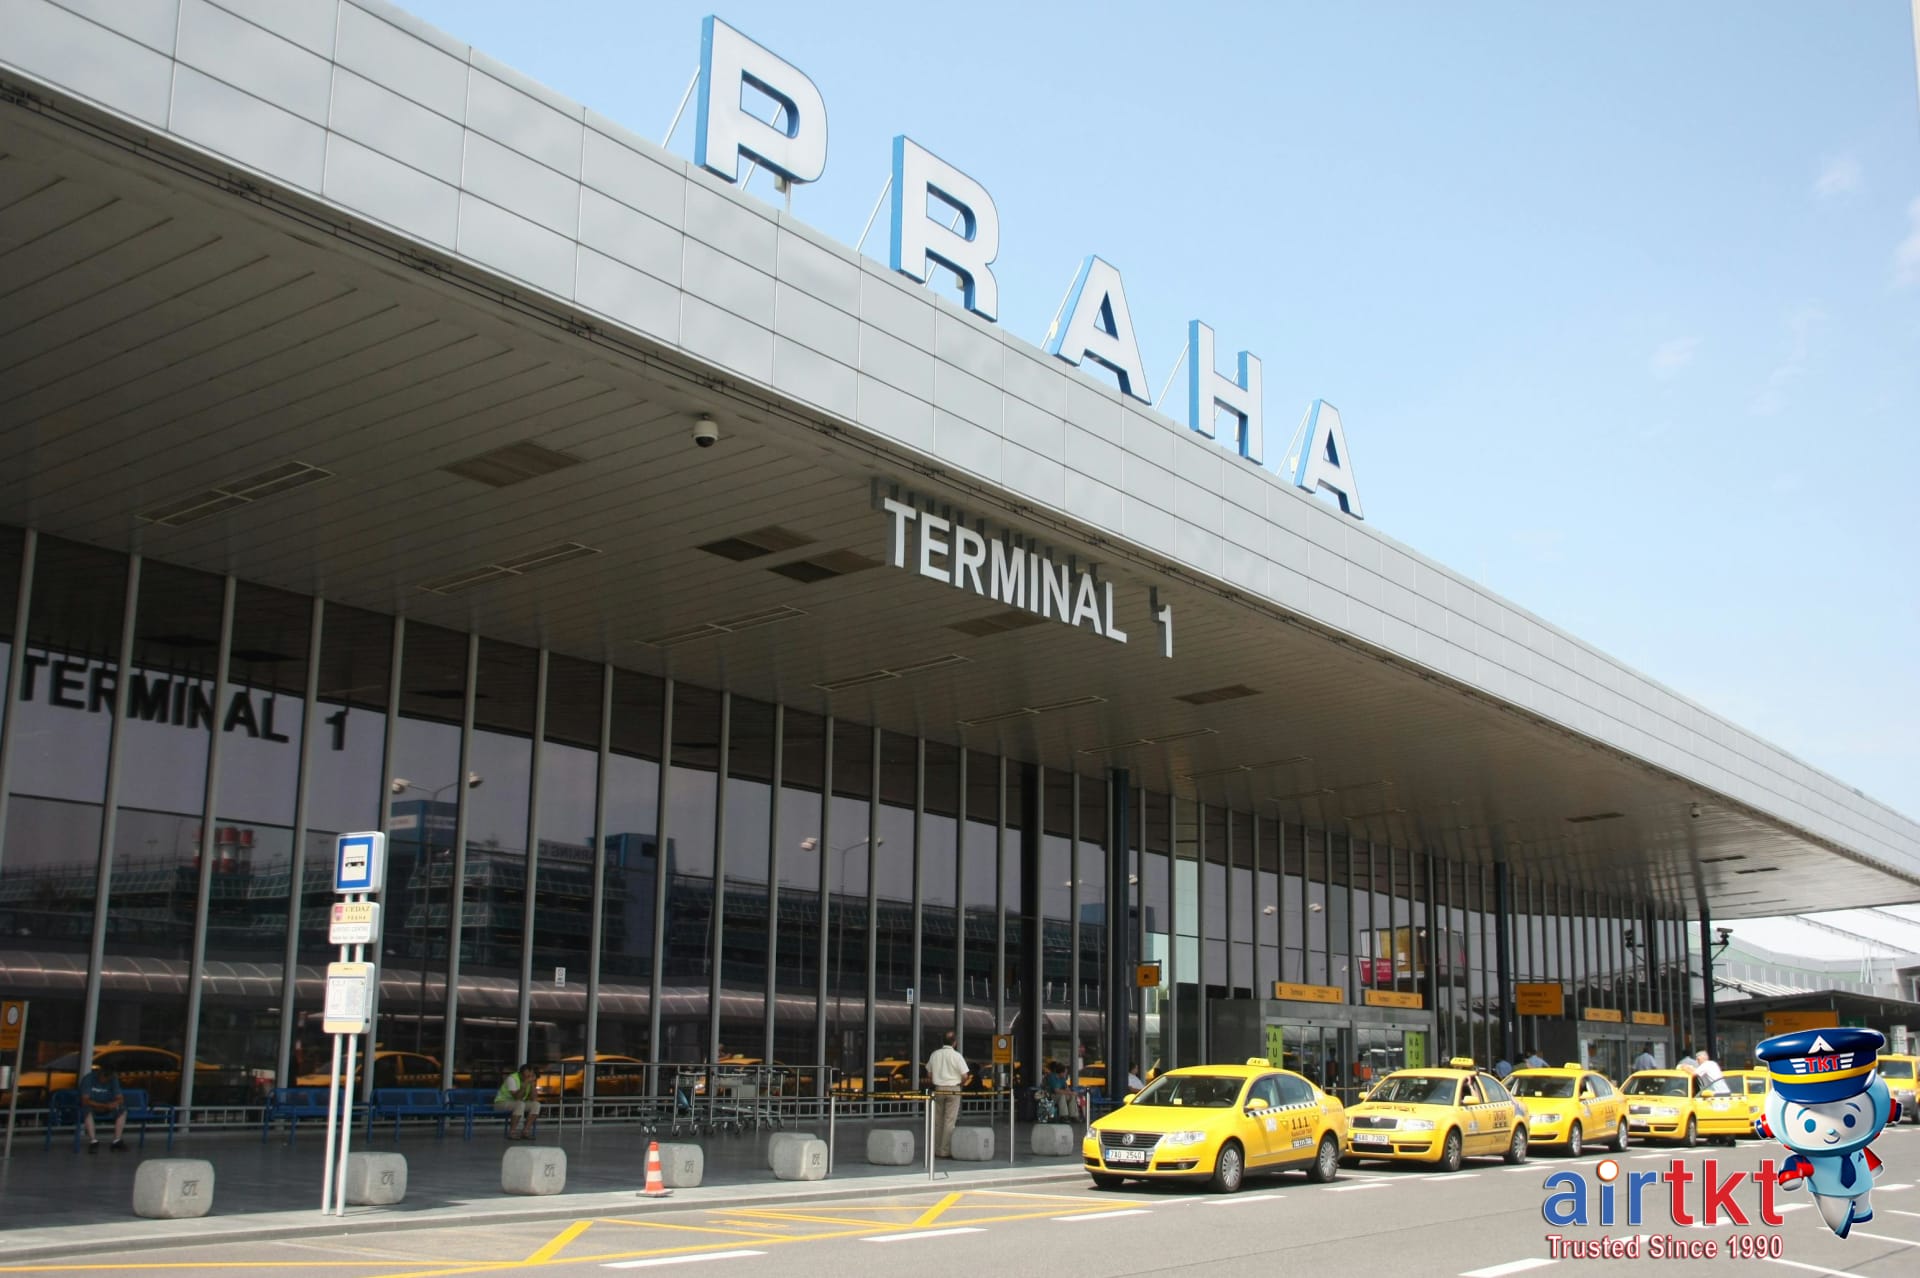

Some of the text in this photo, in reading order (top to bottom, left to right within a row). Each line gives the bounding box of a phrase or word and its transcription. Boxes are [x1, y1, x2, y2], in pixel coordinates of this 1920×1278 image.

[694, 15, 1365, 521] PRAHA
[884, 497, 1173, 658] TERMINAL 1
[20, 653, 348, 750] TERMINAL 1
